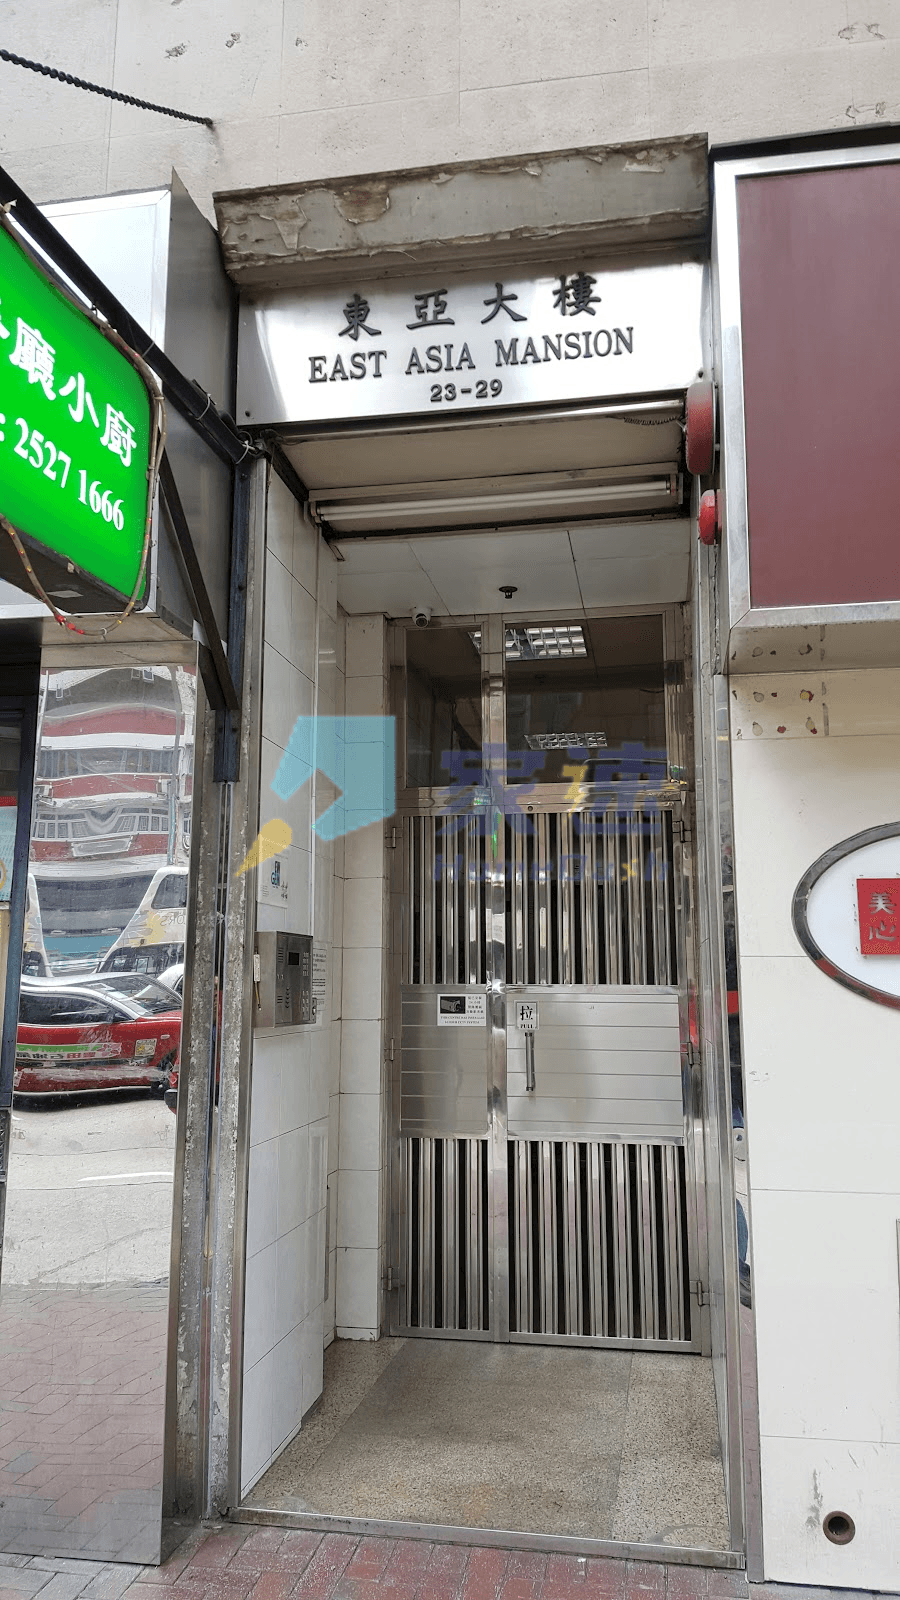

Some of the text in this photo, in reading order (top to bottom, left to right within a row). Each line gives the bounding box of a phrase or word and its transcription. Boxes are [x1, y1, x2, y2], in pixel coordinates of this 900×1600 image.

[338, 271, 602, 341] 東亞大樓
[308, 326, 634, 383] EAST ASIA MANSION
[0, 304, 137, 467] 廳小廚
[430, 379, 503, 402] 23-29
[14, 417, 71, 488] 2527
[78, 469, 124, 531] 1666
[868, 892, 897, 942] 美心
[520, 1005, 533, 1021] 拉
